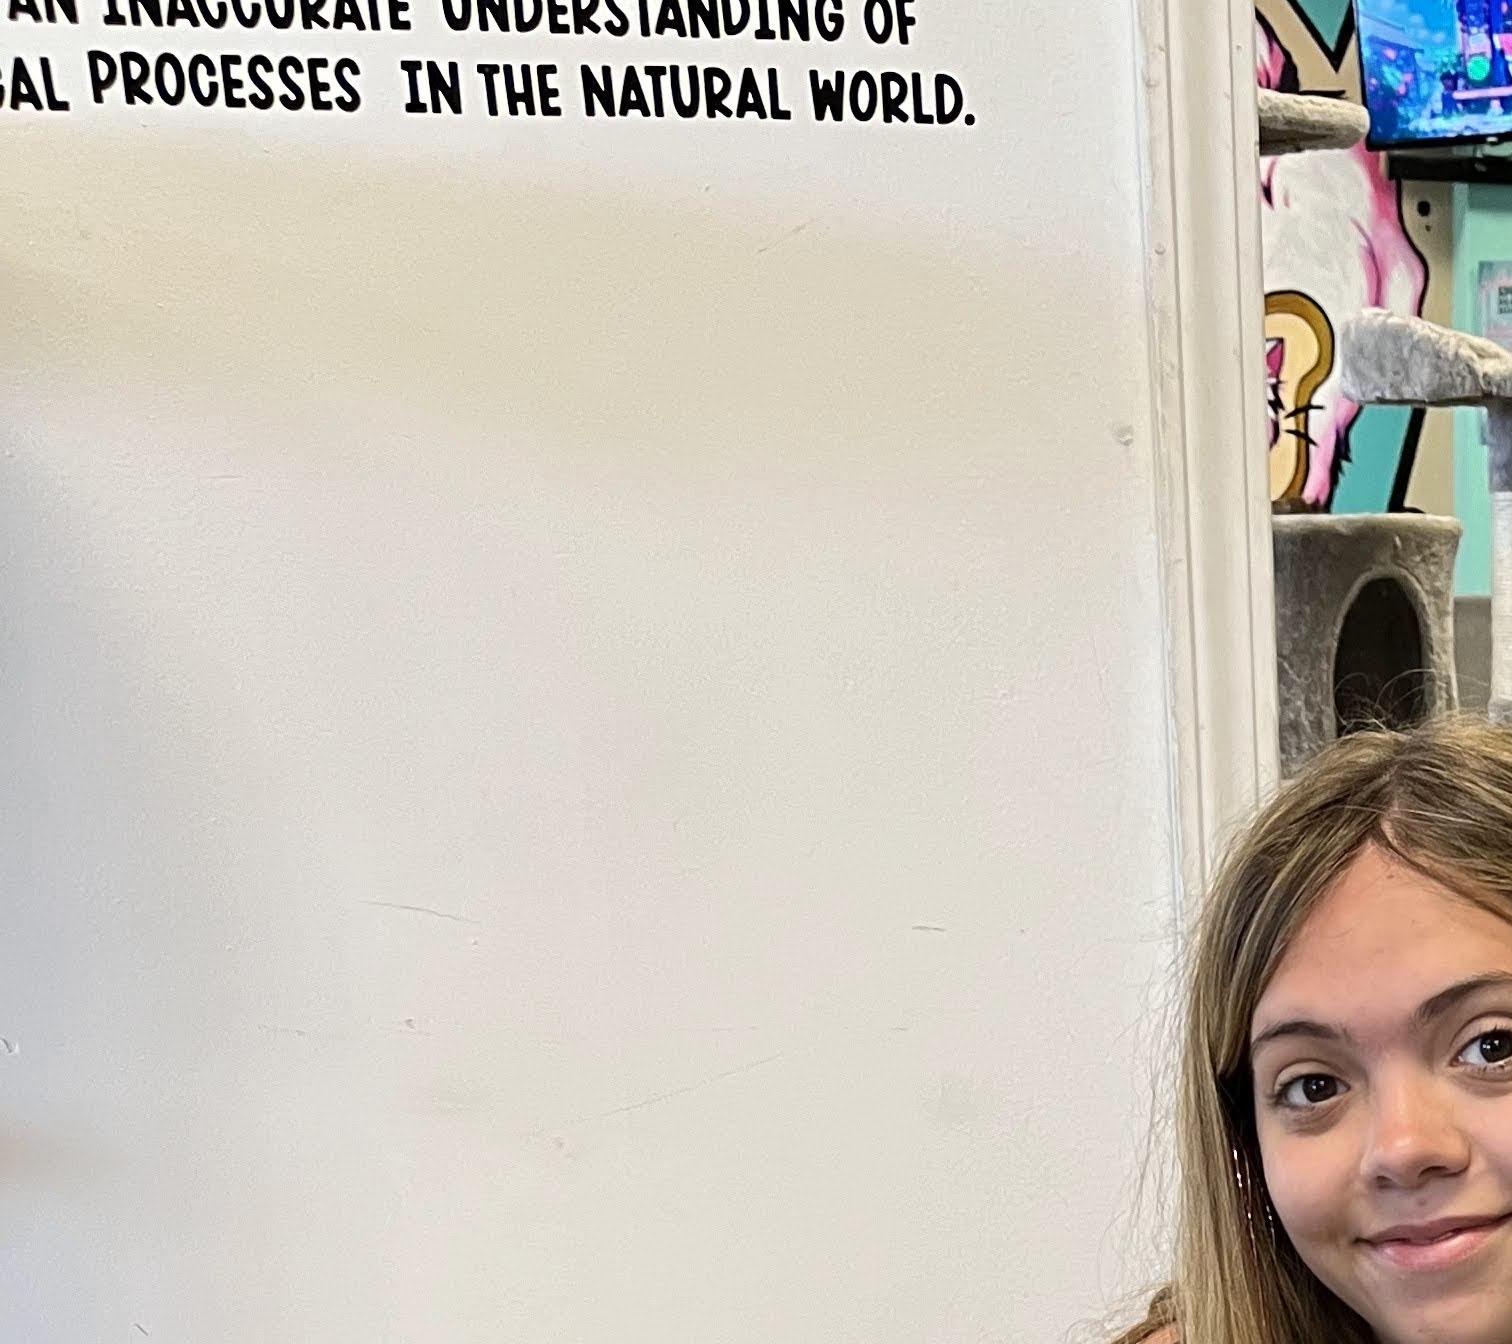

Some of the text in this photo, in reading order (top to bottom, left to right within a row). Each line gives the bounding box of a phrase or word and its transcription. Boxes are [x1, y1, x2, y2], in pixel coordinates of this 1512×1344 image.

[441, 0, 845, 43] UNDERSTANDING
[863, 0, 916, 45] OF
[0, 50, 976, 126] AL PROCESSES IN THE NATURAL WORLD.
